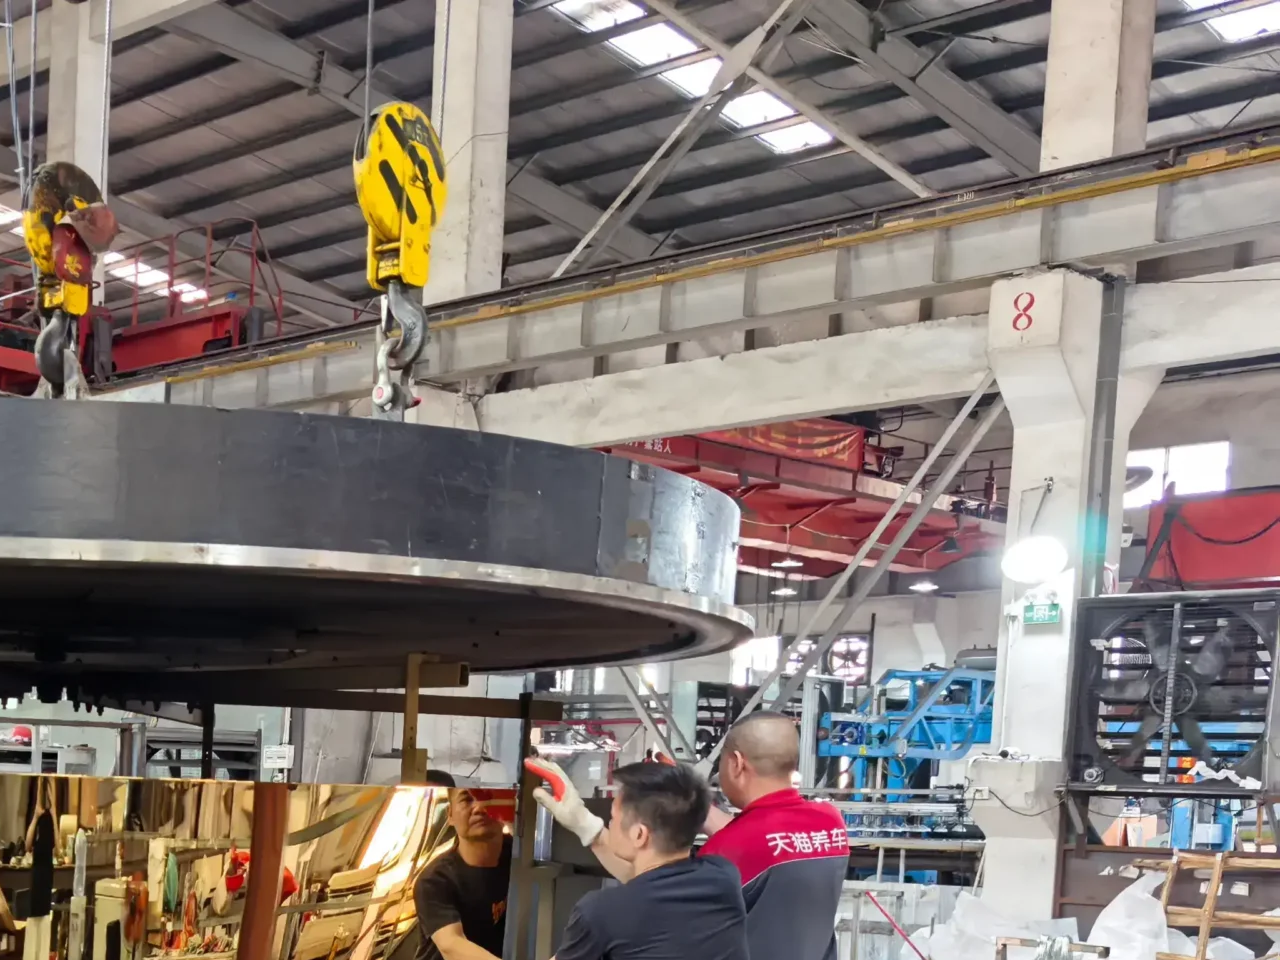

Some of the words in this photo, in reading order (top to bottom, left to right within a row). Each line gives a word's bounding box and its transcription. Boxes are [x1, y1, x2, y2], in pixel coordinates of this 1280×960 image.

[1012, 291, 1036, 331] 8
[765, 827, 847, 857] 天猫养车
